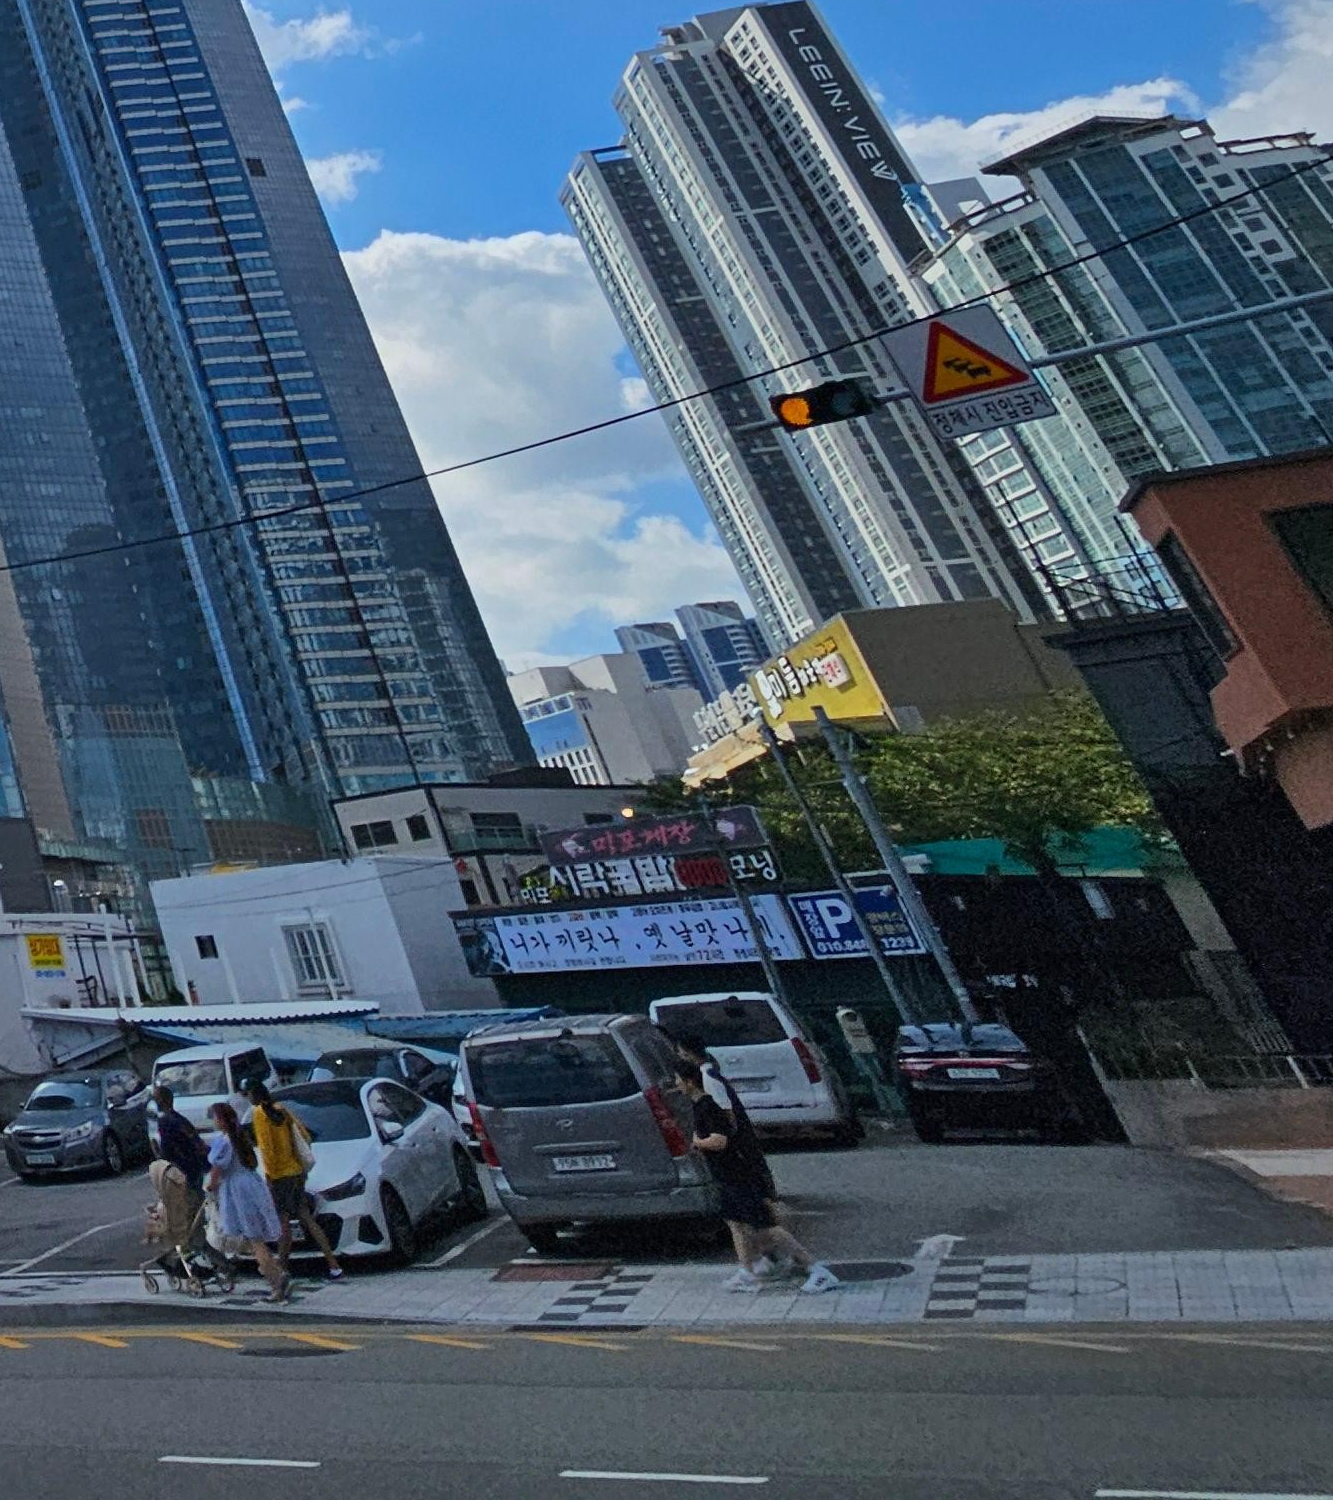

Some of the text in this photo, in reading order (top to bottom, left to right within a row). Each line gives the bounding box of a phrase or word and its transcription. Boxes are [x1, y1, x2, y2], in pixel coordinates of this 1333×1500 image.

[933, 390, 1050, 434] 정체시 진입금지
[815, 898, 852, 939] P
